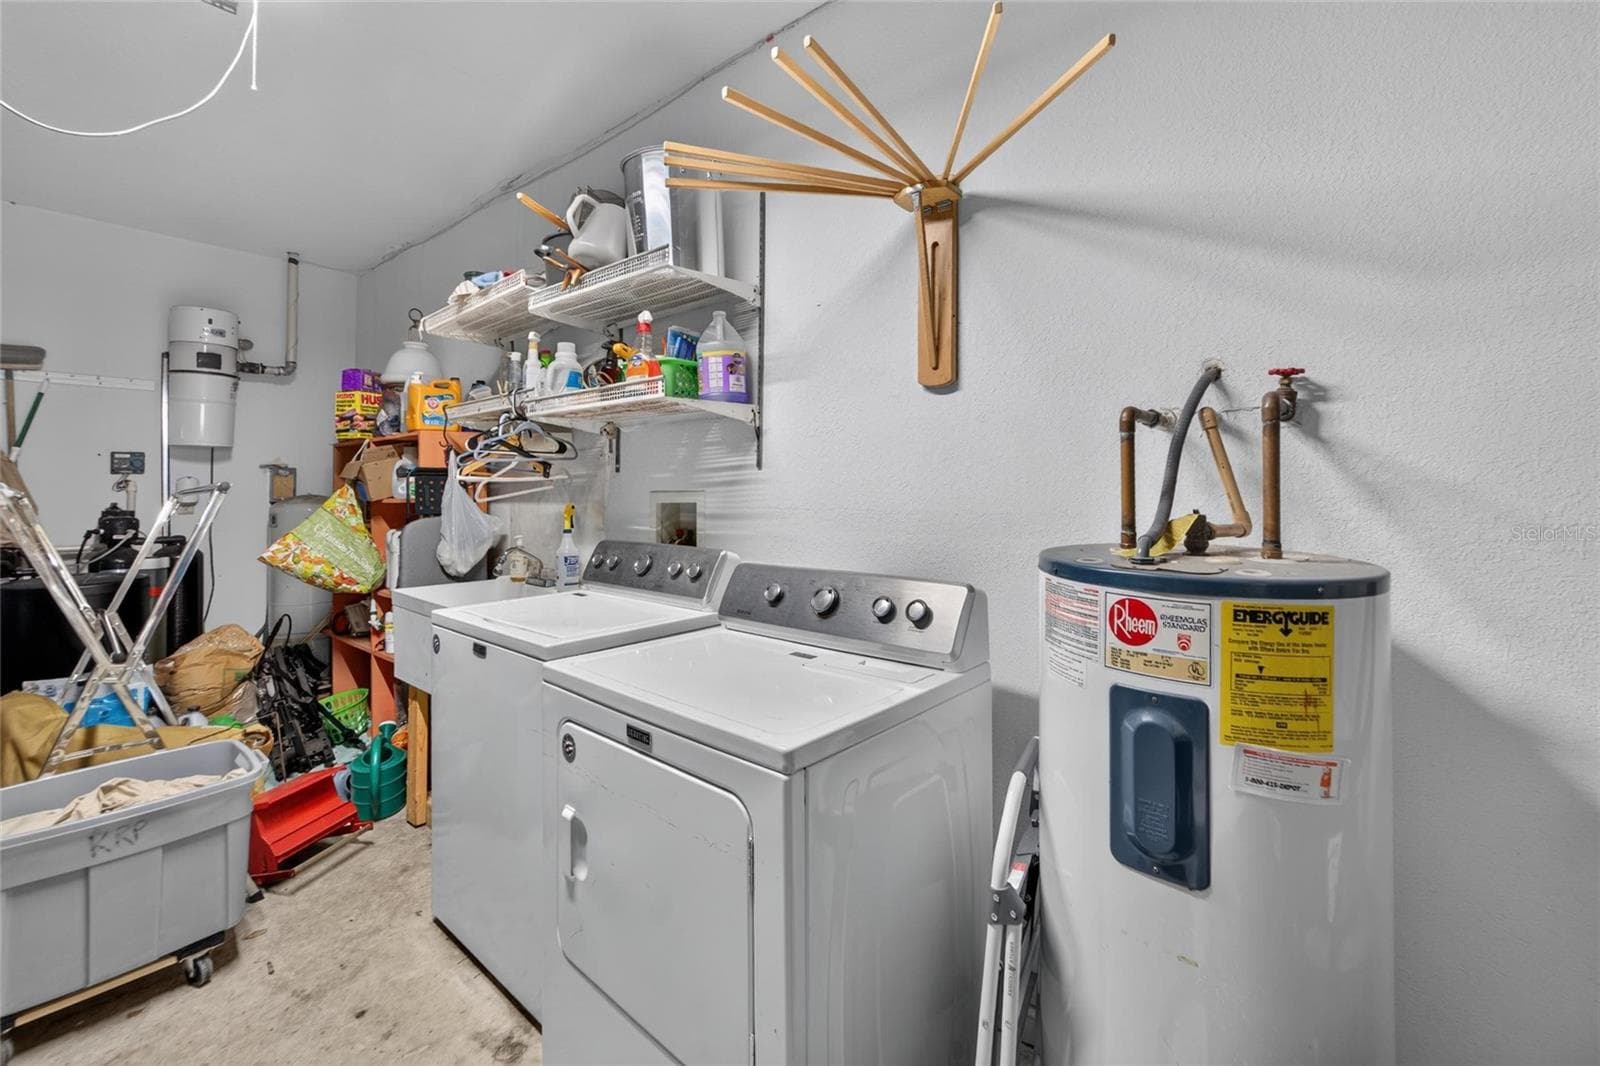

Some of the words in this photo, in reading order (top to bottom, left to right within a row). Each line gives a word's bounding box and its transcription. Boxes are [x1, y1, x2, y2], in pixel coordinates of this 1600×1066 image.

[361, 394, 383, 405] HUS
[1113, 599, 1156, 639] Rheem
[1162, 621, 1206, 633] STANDARD
